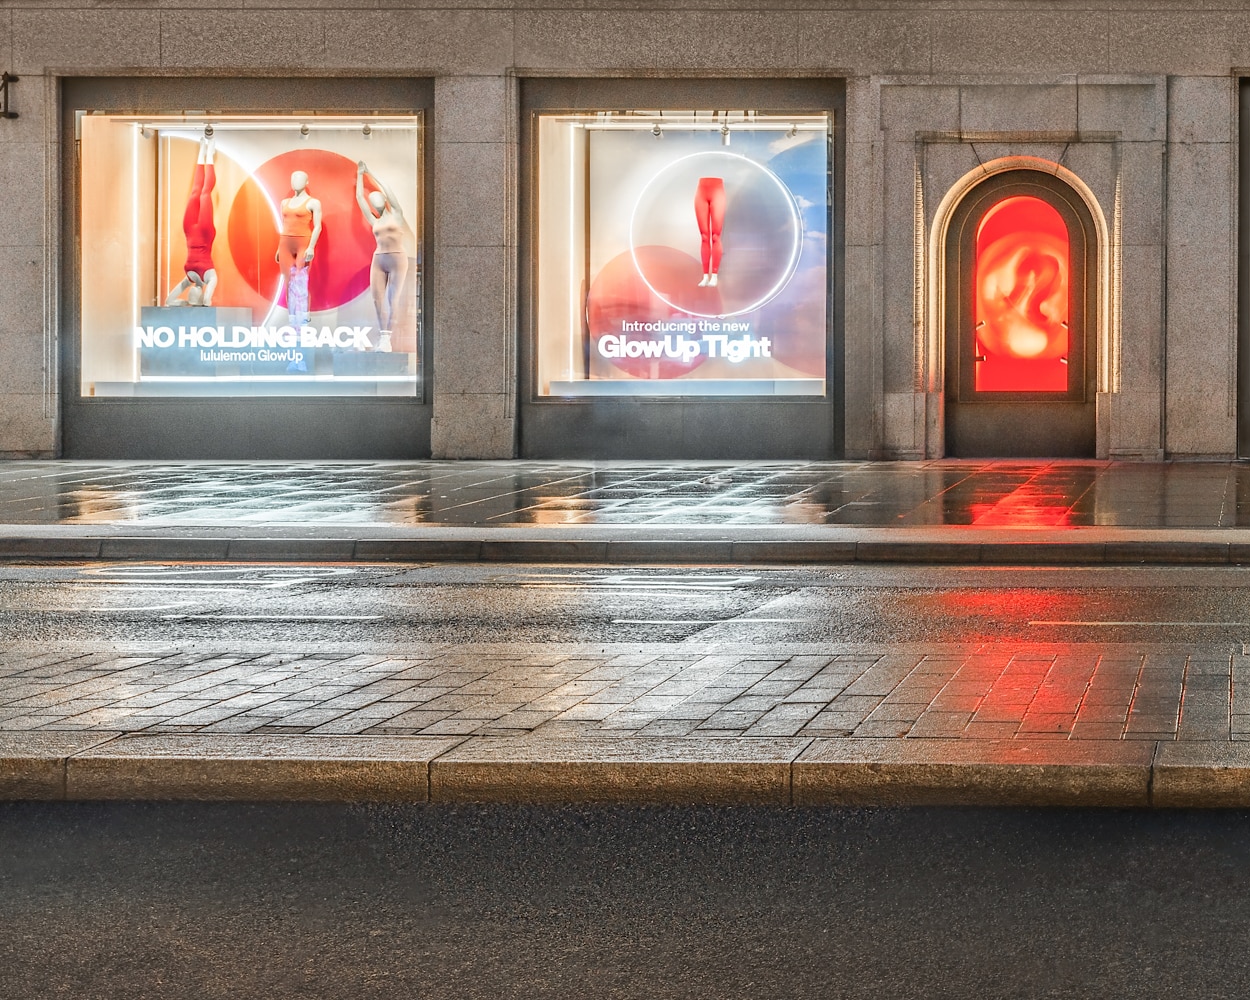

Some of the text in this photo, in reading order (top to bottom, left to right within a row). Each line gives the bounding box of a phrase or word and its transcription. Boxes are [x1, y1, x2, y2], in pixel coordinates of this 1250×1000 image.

[622, 320, 750, 334] Introducing the new
[135, 326, 373, 348] NO HOLDING BACK
[200, 350, 303, 362] lululemon GlowUp
[598, 334, 771, 362] GlowUp Tight
